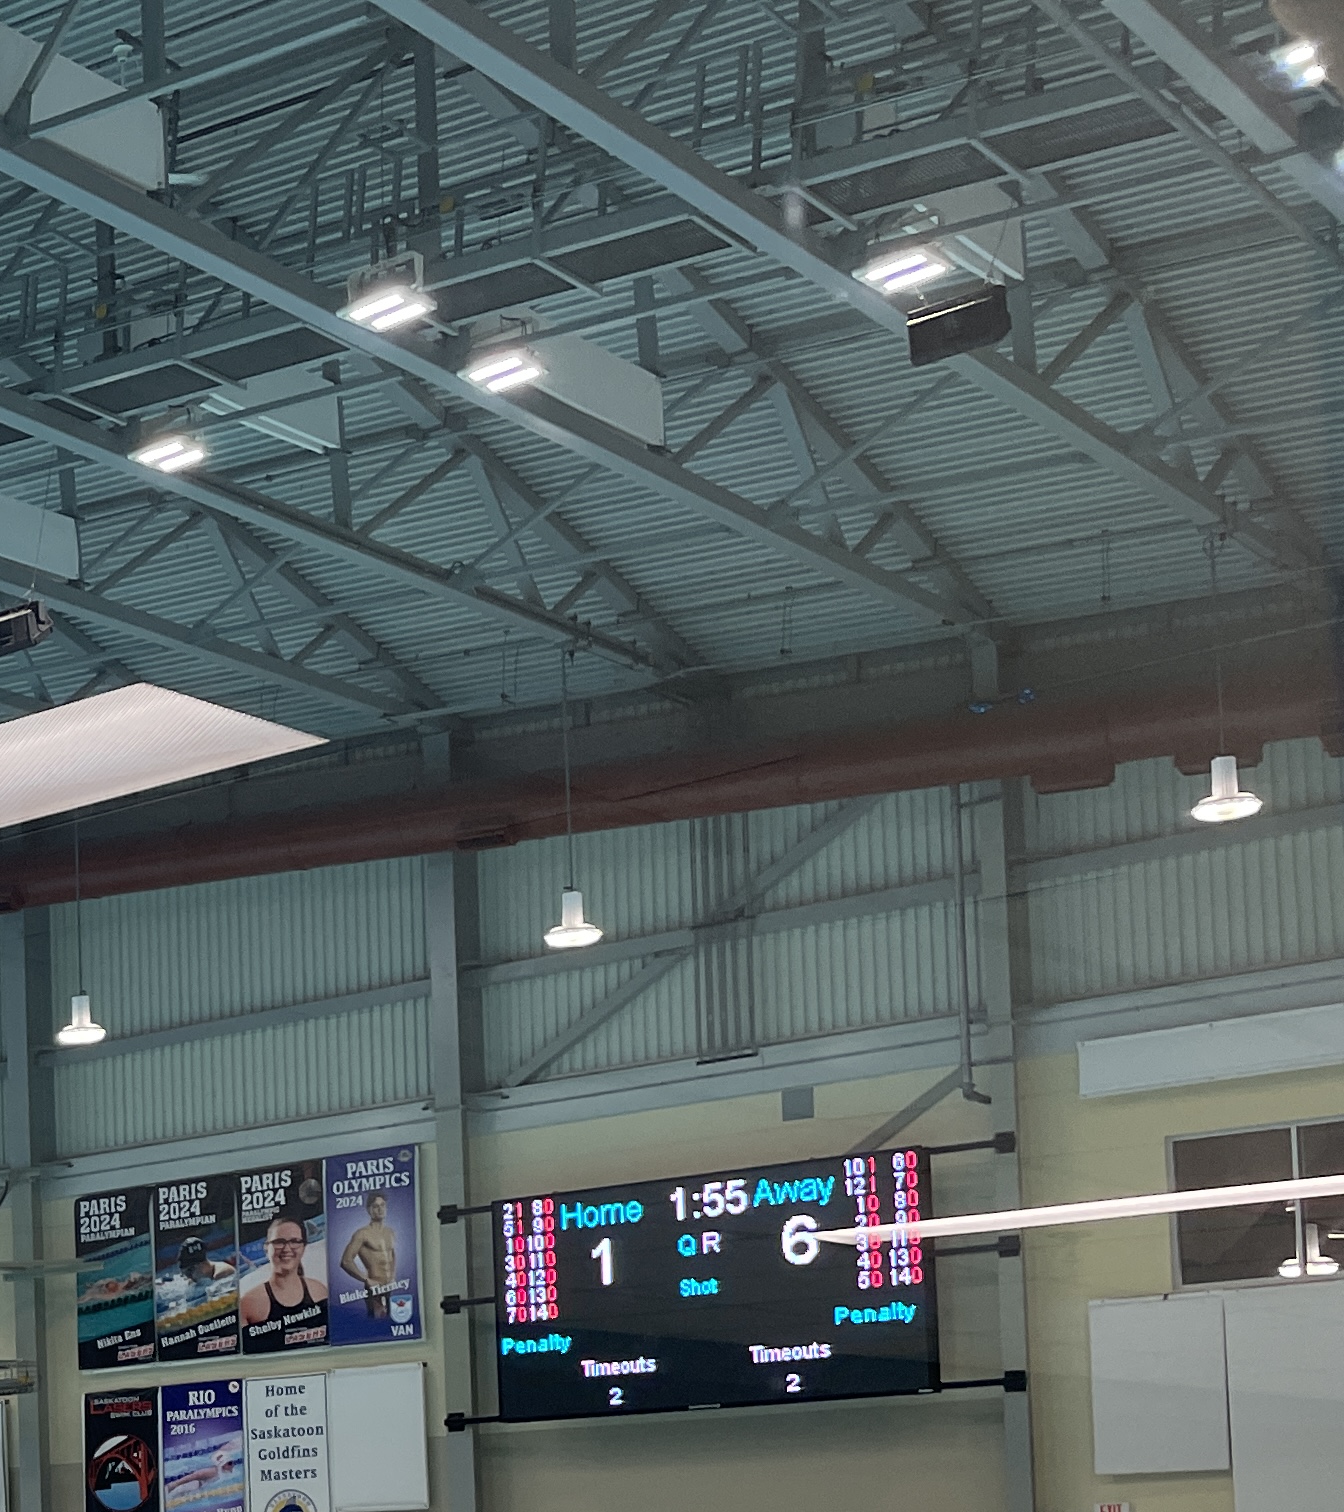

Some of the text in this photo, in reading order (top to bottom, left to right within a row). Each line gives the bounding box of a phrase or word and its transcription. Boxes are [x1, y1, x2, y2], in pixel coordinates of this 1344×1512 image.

[346, 1157, 394, 1179] PARIS
[158, 1181, 207, 1204] PARIS
[240, 1169, 292, 1194] PARIS
[332, 1171, 410, 1196] OLYMPICS
[753, 1174, 836, 1208] Away
[79, 1195, 126, 1217] PARIS
[159, 1200, 201, 1220] 2024
[241, 1188, 286, 1211] 2024
[335, 1194, 363, 1209] 2024
[670, 1178, 748, 1222] 1:55
[80, 1213, 121, 1233] 2024
[159, 1214, 216, 1231] PARALYMPIAN
[559, 1200, 644, 1231] Home
[80, 1227, 135, 1243] PARALYMPIAN
[677, 1231, 722, 1257] Q R
[781, 1214, 820, 1266] 6
[590, 1237, 615, 1287] 1
[339, 1278, 411, 1305] Blake Tierney
[679, 1276, 720, 1298] Shot
[833, 1302, 917, 1326] Penalty
[390, 1323, 414, 1337] VAN
[501, 1333, 572, 1356] Penalty
[749, 1341, 832, 1364] Timeouts
[581, 1356, 658, 1378] Timeouts
[265, 1384, 306, 1398] Home
[786, 1374, 801, 1393] 2
[188, 1389, 216, 1406] RIO
[609, 1387, 625, 1406] 2
[166, 1406, 239, 1422] PARALYMPICS
[265, 1403, 308, 1418] of the
[170, 1423, 196, 1436] 2016
[250, 1425, 324, 1441] Saskatoon
[258, 1445, 318, 1461] Goldfins
[260, 1468, 318, 1482] Masters
